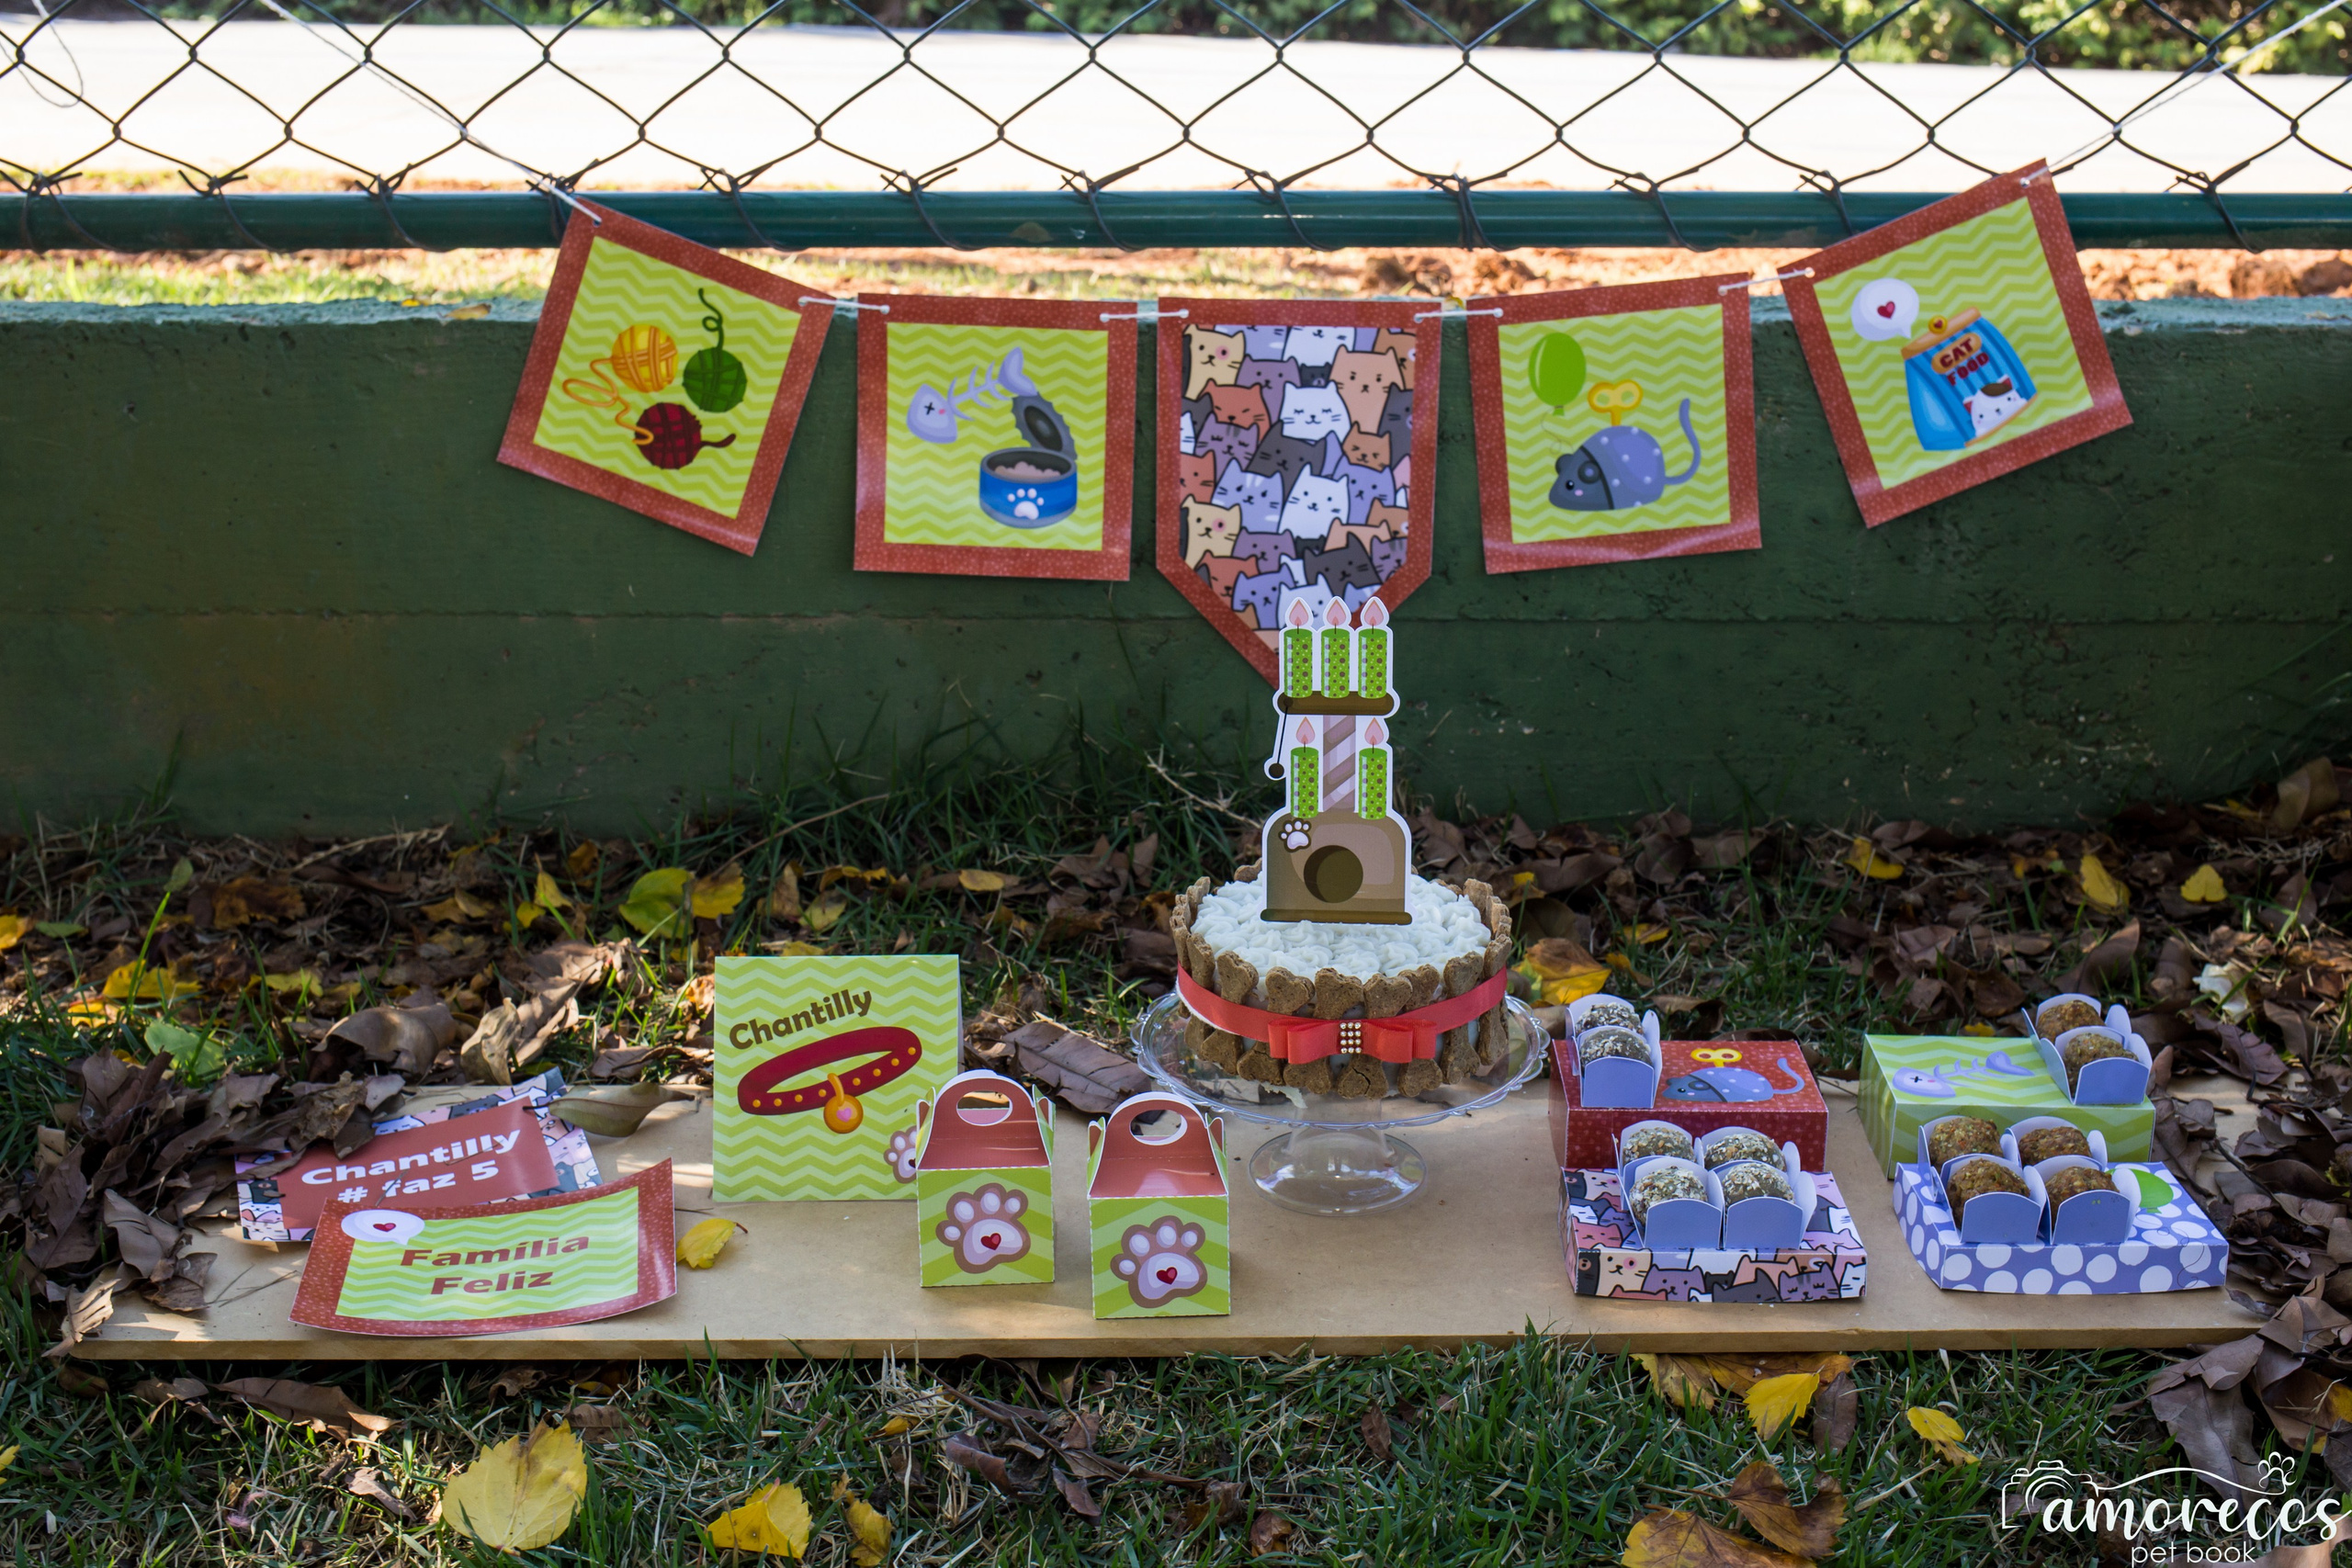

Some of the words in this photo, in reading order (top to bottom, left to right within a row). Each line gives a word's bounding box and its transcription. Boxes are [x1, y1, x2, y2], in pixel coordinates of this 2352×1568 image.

[1939, 337, 1973, 369] CAT
[1946, 352, 1989, 386] FOOD
[729, 988, 872, 1050] Chantilly
[300, 1129, 521, 1186] Chantilly
[381, 1172, 456, 1198] faz
[470, 1159, 499, 1181] 5
[400, 1235, 589, 1267] Família
[430, 1270, 554, 1295] Feliz
